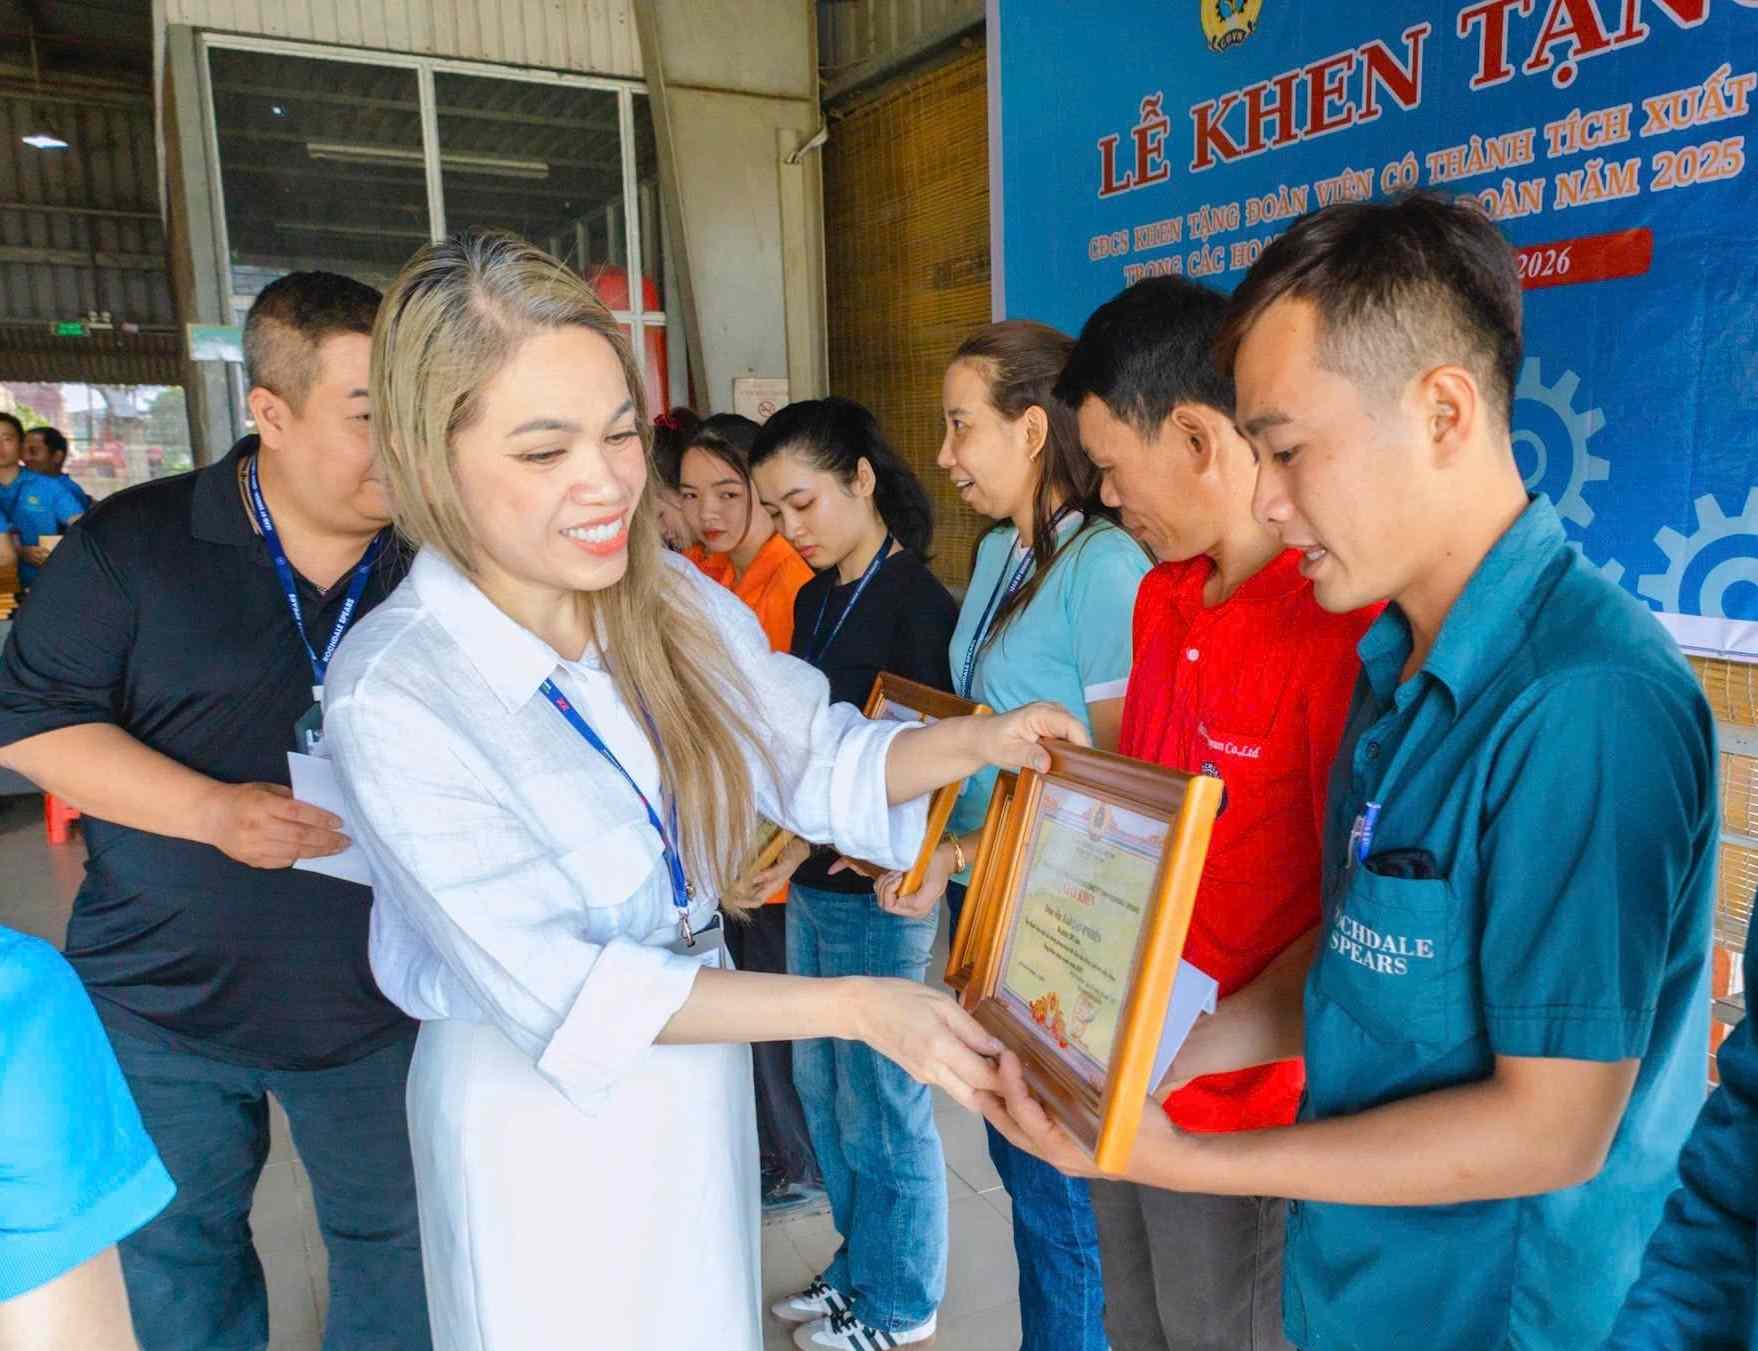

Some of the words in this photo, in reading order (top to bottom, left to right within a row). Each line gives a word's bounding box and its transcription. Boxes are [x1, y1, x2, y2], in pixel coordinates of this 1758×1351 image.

[1098, 91, 1169, 197] LỄ
[1190, 23, 1430, 172] KHEN
[1134, 217, 1182, 251] KHEN
[1188, 203, 1240, 242] TẶNG
[1246, 184, 1308, 227] ĐOÀN
[1315, 167, 1374, 206] VIÊN
[1380, 151, 1419, 193] CÓ
[1426, 128, 1536, 186] THÀNH
[1544, 104, 1632, 157] TÍCH
[1640, 63, 1757, 137] XUẤT
[1187, 246, 1225, 278] CÁC
[1455, 176, 1546, 221] OÀN
[1553, 157, 1641, 210] NĂM
[1650, 136, 1745, 191] 2025
[1518, 246, 1573, 279] 2026
[1329, 929, 1408, 975] SPEARS
